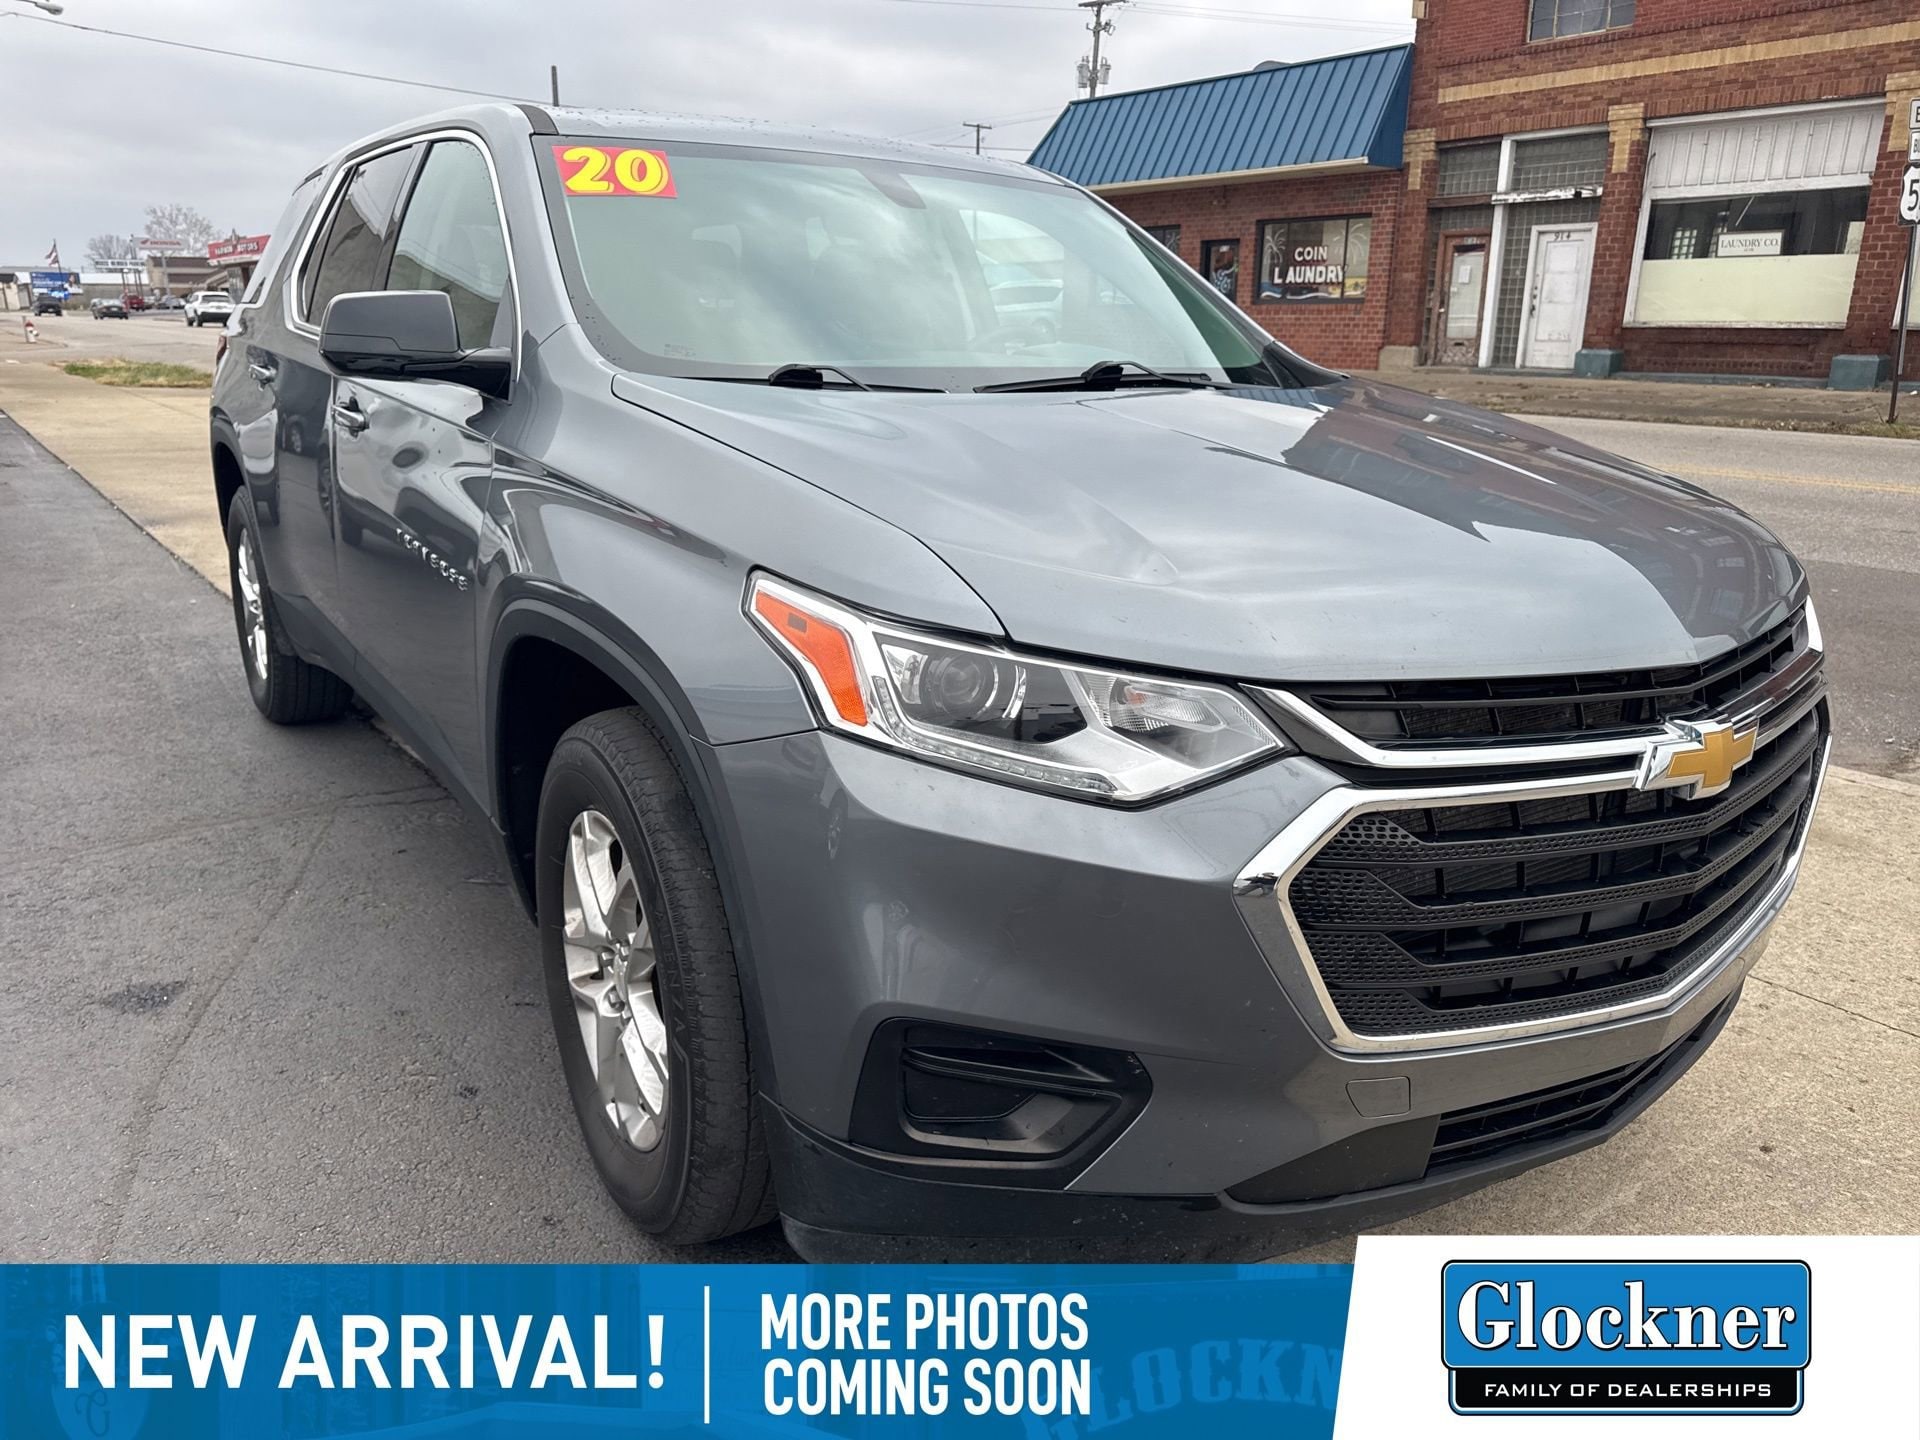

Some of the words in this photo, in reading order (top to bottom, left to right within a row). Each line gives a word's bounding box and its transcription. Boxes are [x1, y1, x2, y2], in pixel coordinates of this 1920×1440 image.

[562, 147, 669, 195] 20
[1907, 179, 1920, 211] 5
[1294, 246, 1328, 261] COIN
[1721, 238, 1762, 248] LAUNDRY
[396, 528, 468, 591] TRAVERSE
